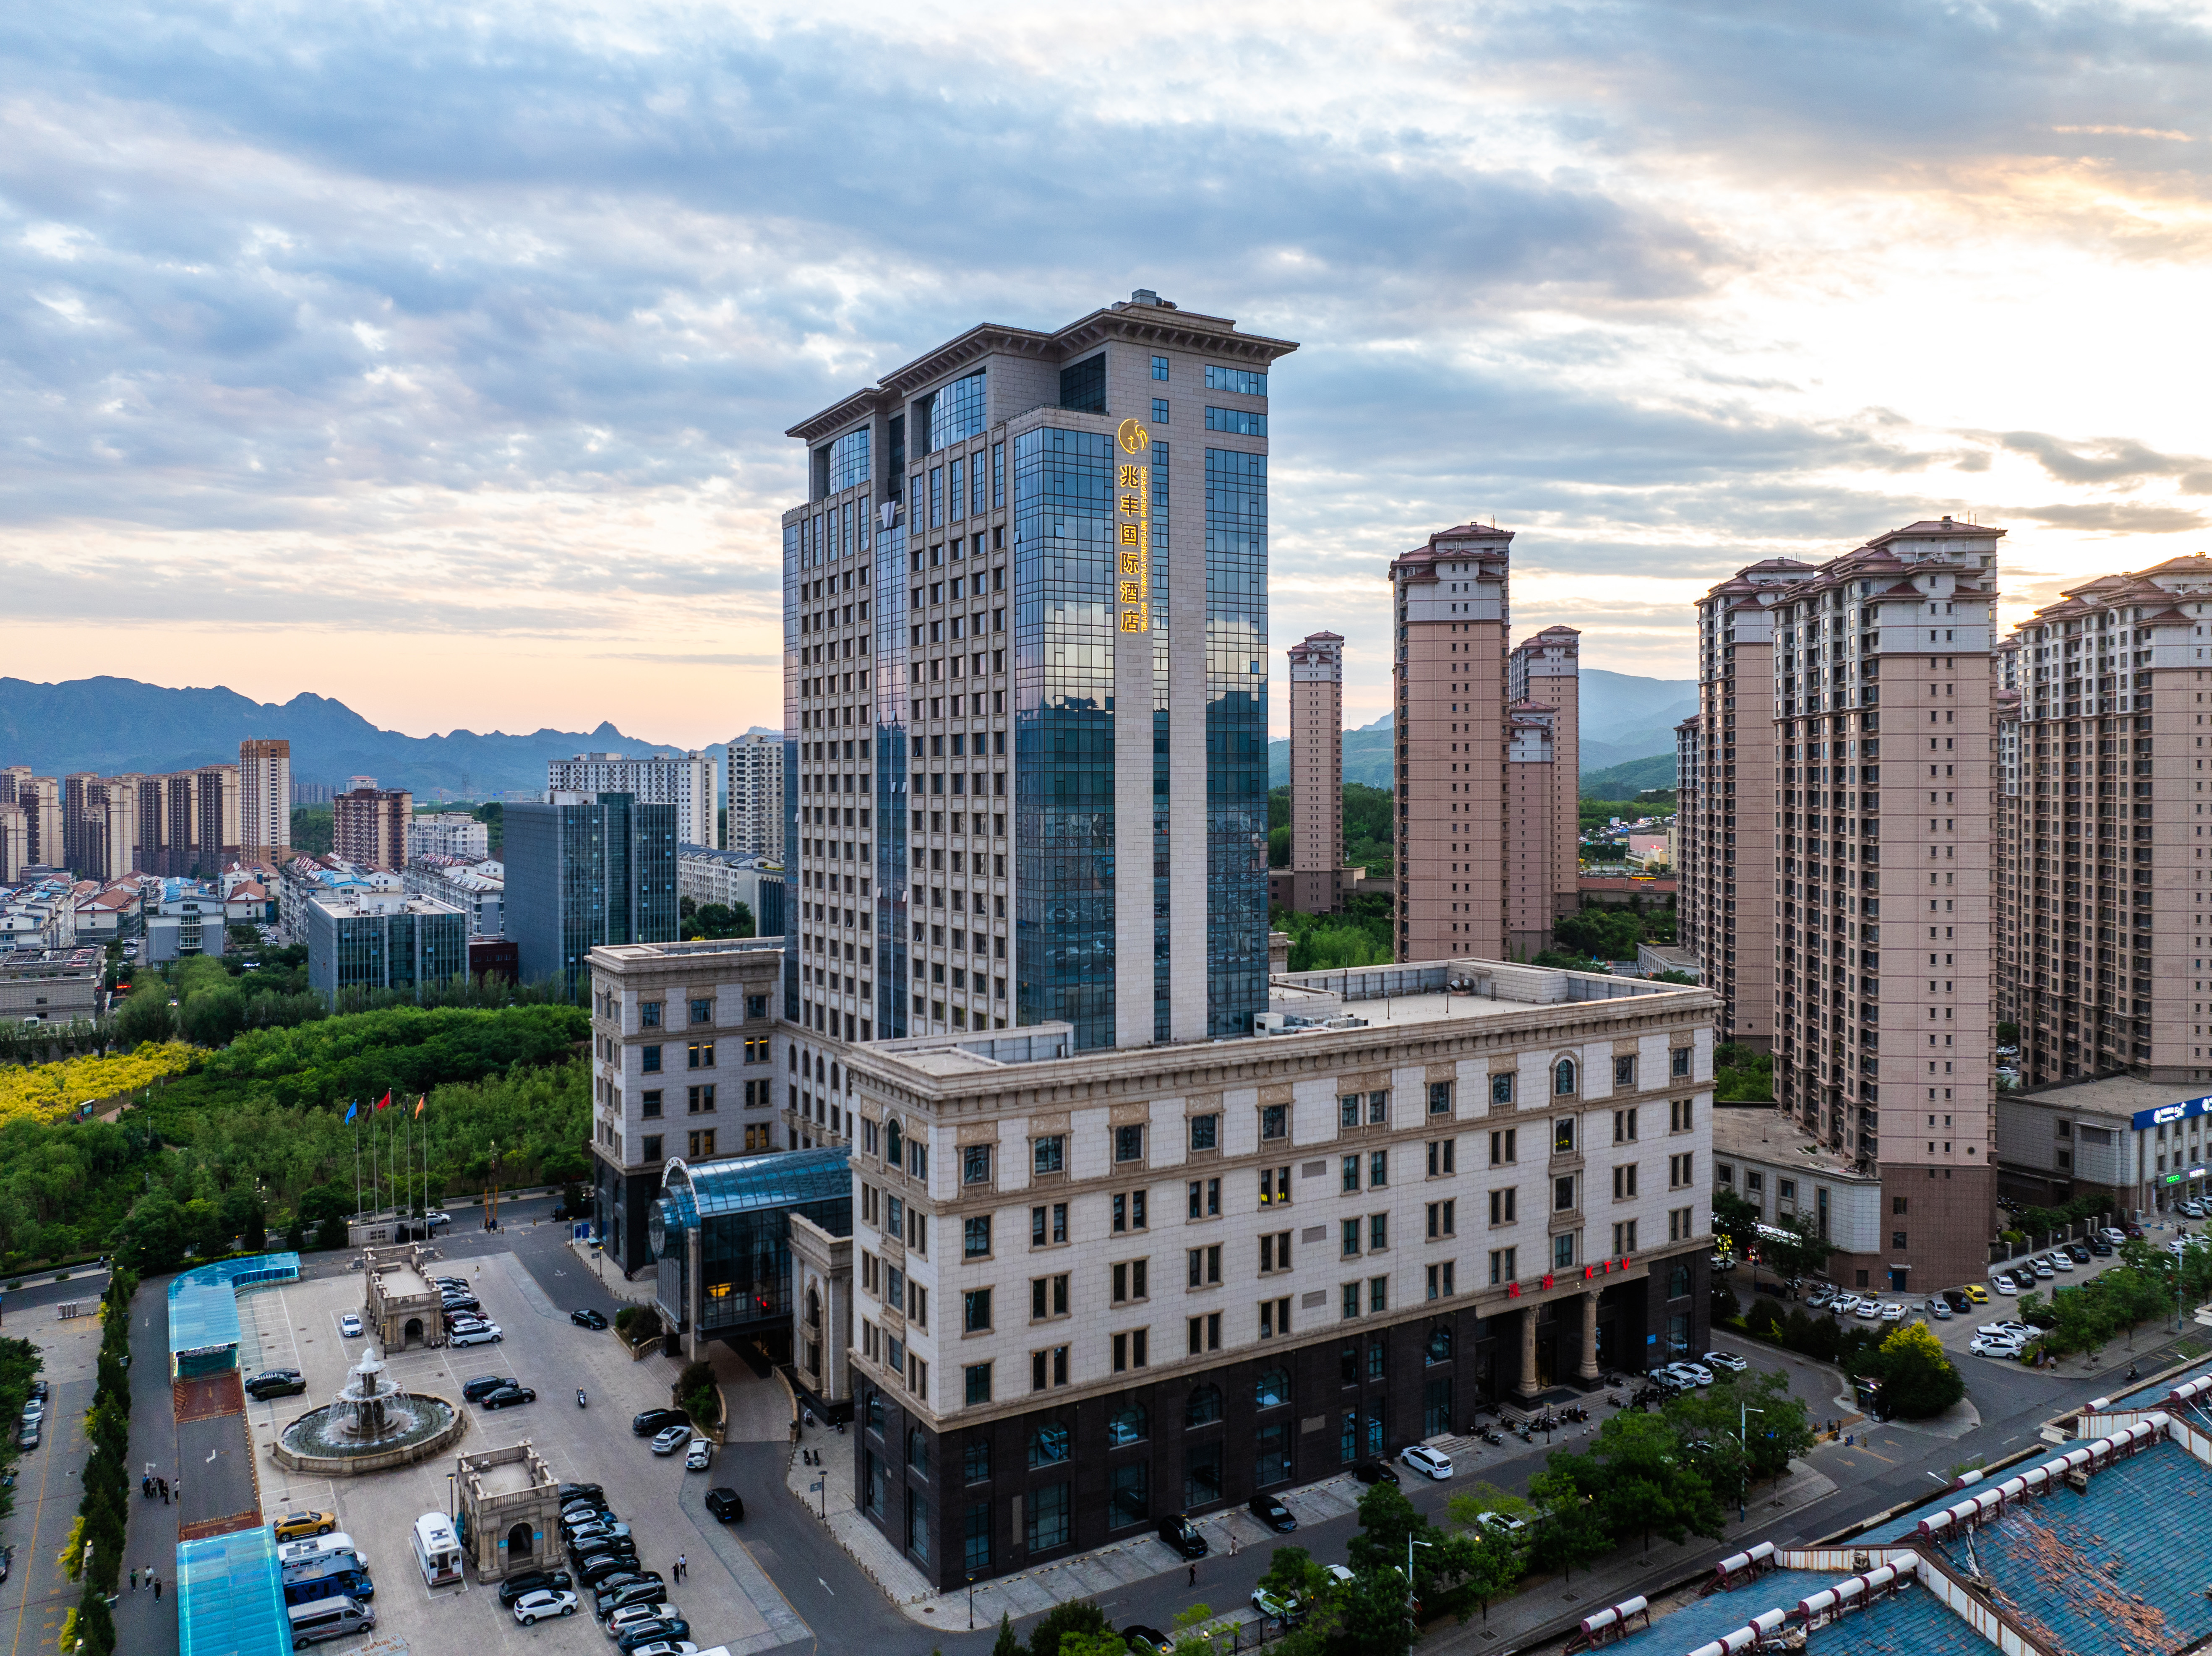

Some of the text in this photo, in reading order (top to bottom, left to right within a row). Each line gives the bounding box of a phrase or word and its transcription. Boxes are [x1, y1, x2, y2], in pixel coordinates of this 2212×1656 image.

[1120, 464, 1139, 633] 兆丰国际酒店
[1585, 1257, 1630, 1280] KTV
